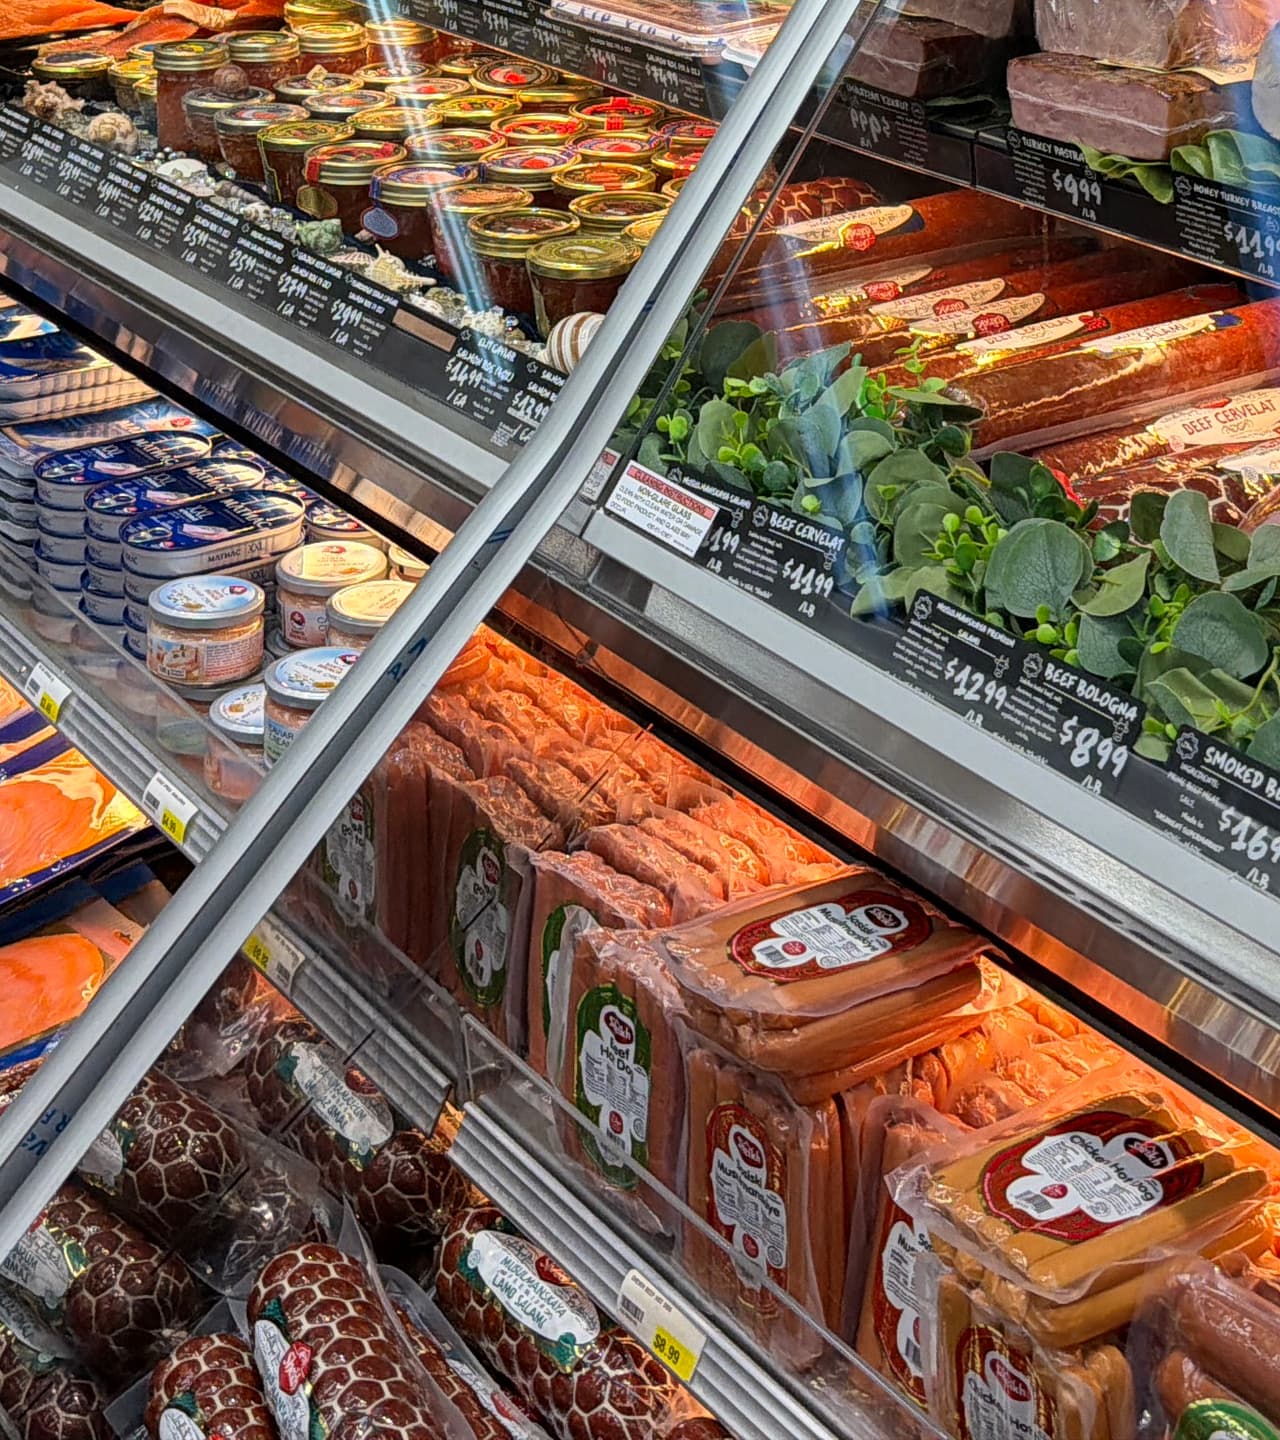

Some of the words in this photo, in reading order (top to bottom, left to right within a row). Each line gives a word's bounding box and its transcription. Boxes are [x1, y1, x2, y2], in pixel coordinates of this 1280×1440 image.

[1022, 136, 1052, 153] TURKEY
[1054, 146, 1086, 162] PASTRA
[1052, 168, 1102, 207] $999
[1194, 182, 1219, 200] HONEY
[1220, 191, 1250, 208] TURKEY
[1082, 208, 1096, 221] /LB
[1258, 262, 1275, 278] /LB
[445, 357, 484, 388] $1499
[456, 347, 482, 367] SALMON
[1182, 416, 1213, 436] BEEF
[1213, 398, 1277, 427] CERVELAT
[638, 485, 671, 508] NON-GLARE
[671, 502, 692, 521] GLASS
[770, 512, 795, 533] BEEF
[795, 521, 846, 552] CERVELAT
[706, 557, 723, 574] /LB
[781, 558, 834, 598] $1199
[798, 601, 816, 618] /LB
[943, 658, 1008, 710] $1299
[1043, 662, 1078, 689] BEEF
[1077, 679, 1138, 722] BOLOGNA
[963, 709, 984, 728] /LB
[1058, 715, 1129, 778] $899
[1203, 746, 1265, 788] SMOKED
[1080, 775, 1103, 795] /LB
[1246, 867, 1271, 889] /LB
[1069, 1134, 1110, 1165] Chicken
[1110, 1158, 1131, 1184] Hot
[1132, 1178, 1155, 1203] Dog
[492, 1272, 517, 1298] LAMB
[517, 1294, 547, 1329] SALAMI
[500, 1255, 567, 1317] MUSULMANSKAYA
[653, 1333, 681, 1366] $8.99
